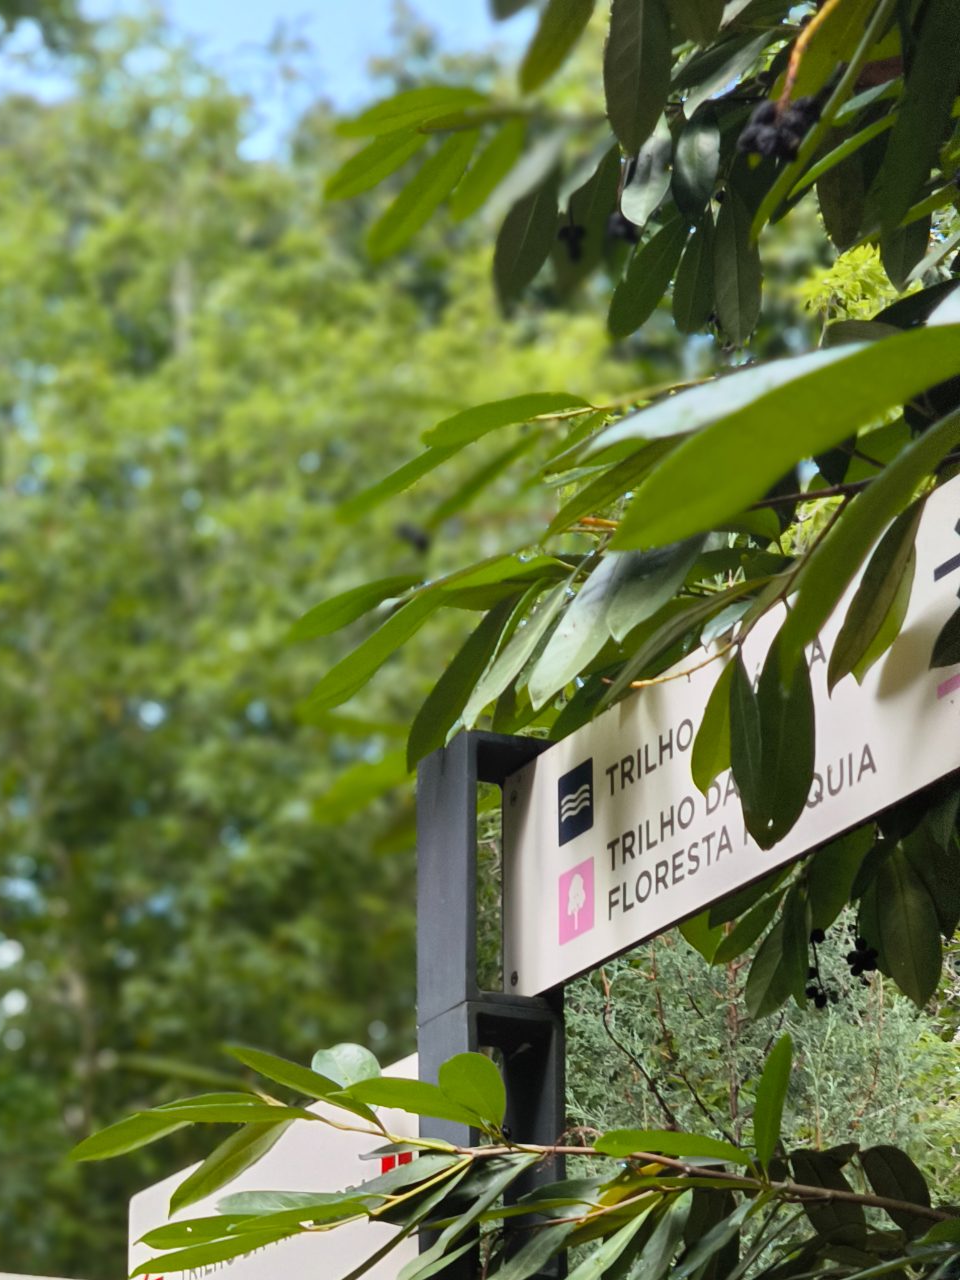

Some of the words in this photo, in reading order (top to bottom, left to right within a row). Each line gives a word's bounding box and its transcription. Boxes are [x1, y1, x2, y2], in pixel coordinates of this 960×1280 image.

[605, 718, 694, 796] TRILHO
[606, 796, 695, 871] TRILHO
[705, 770, 741, 816] DA
[608, 825, 733, 921] FLORESTA
